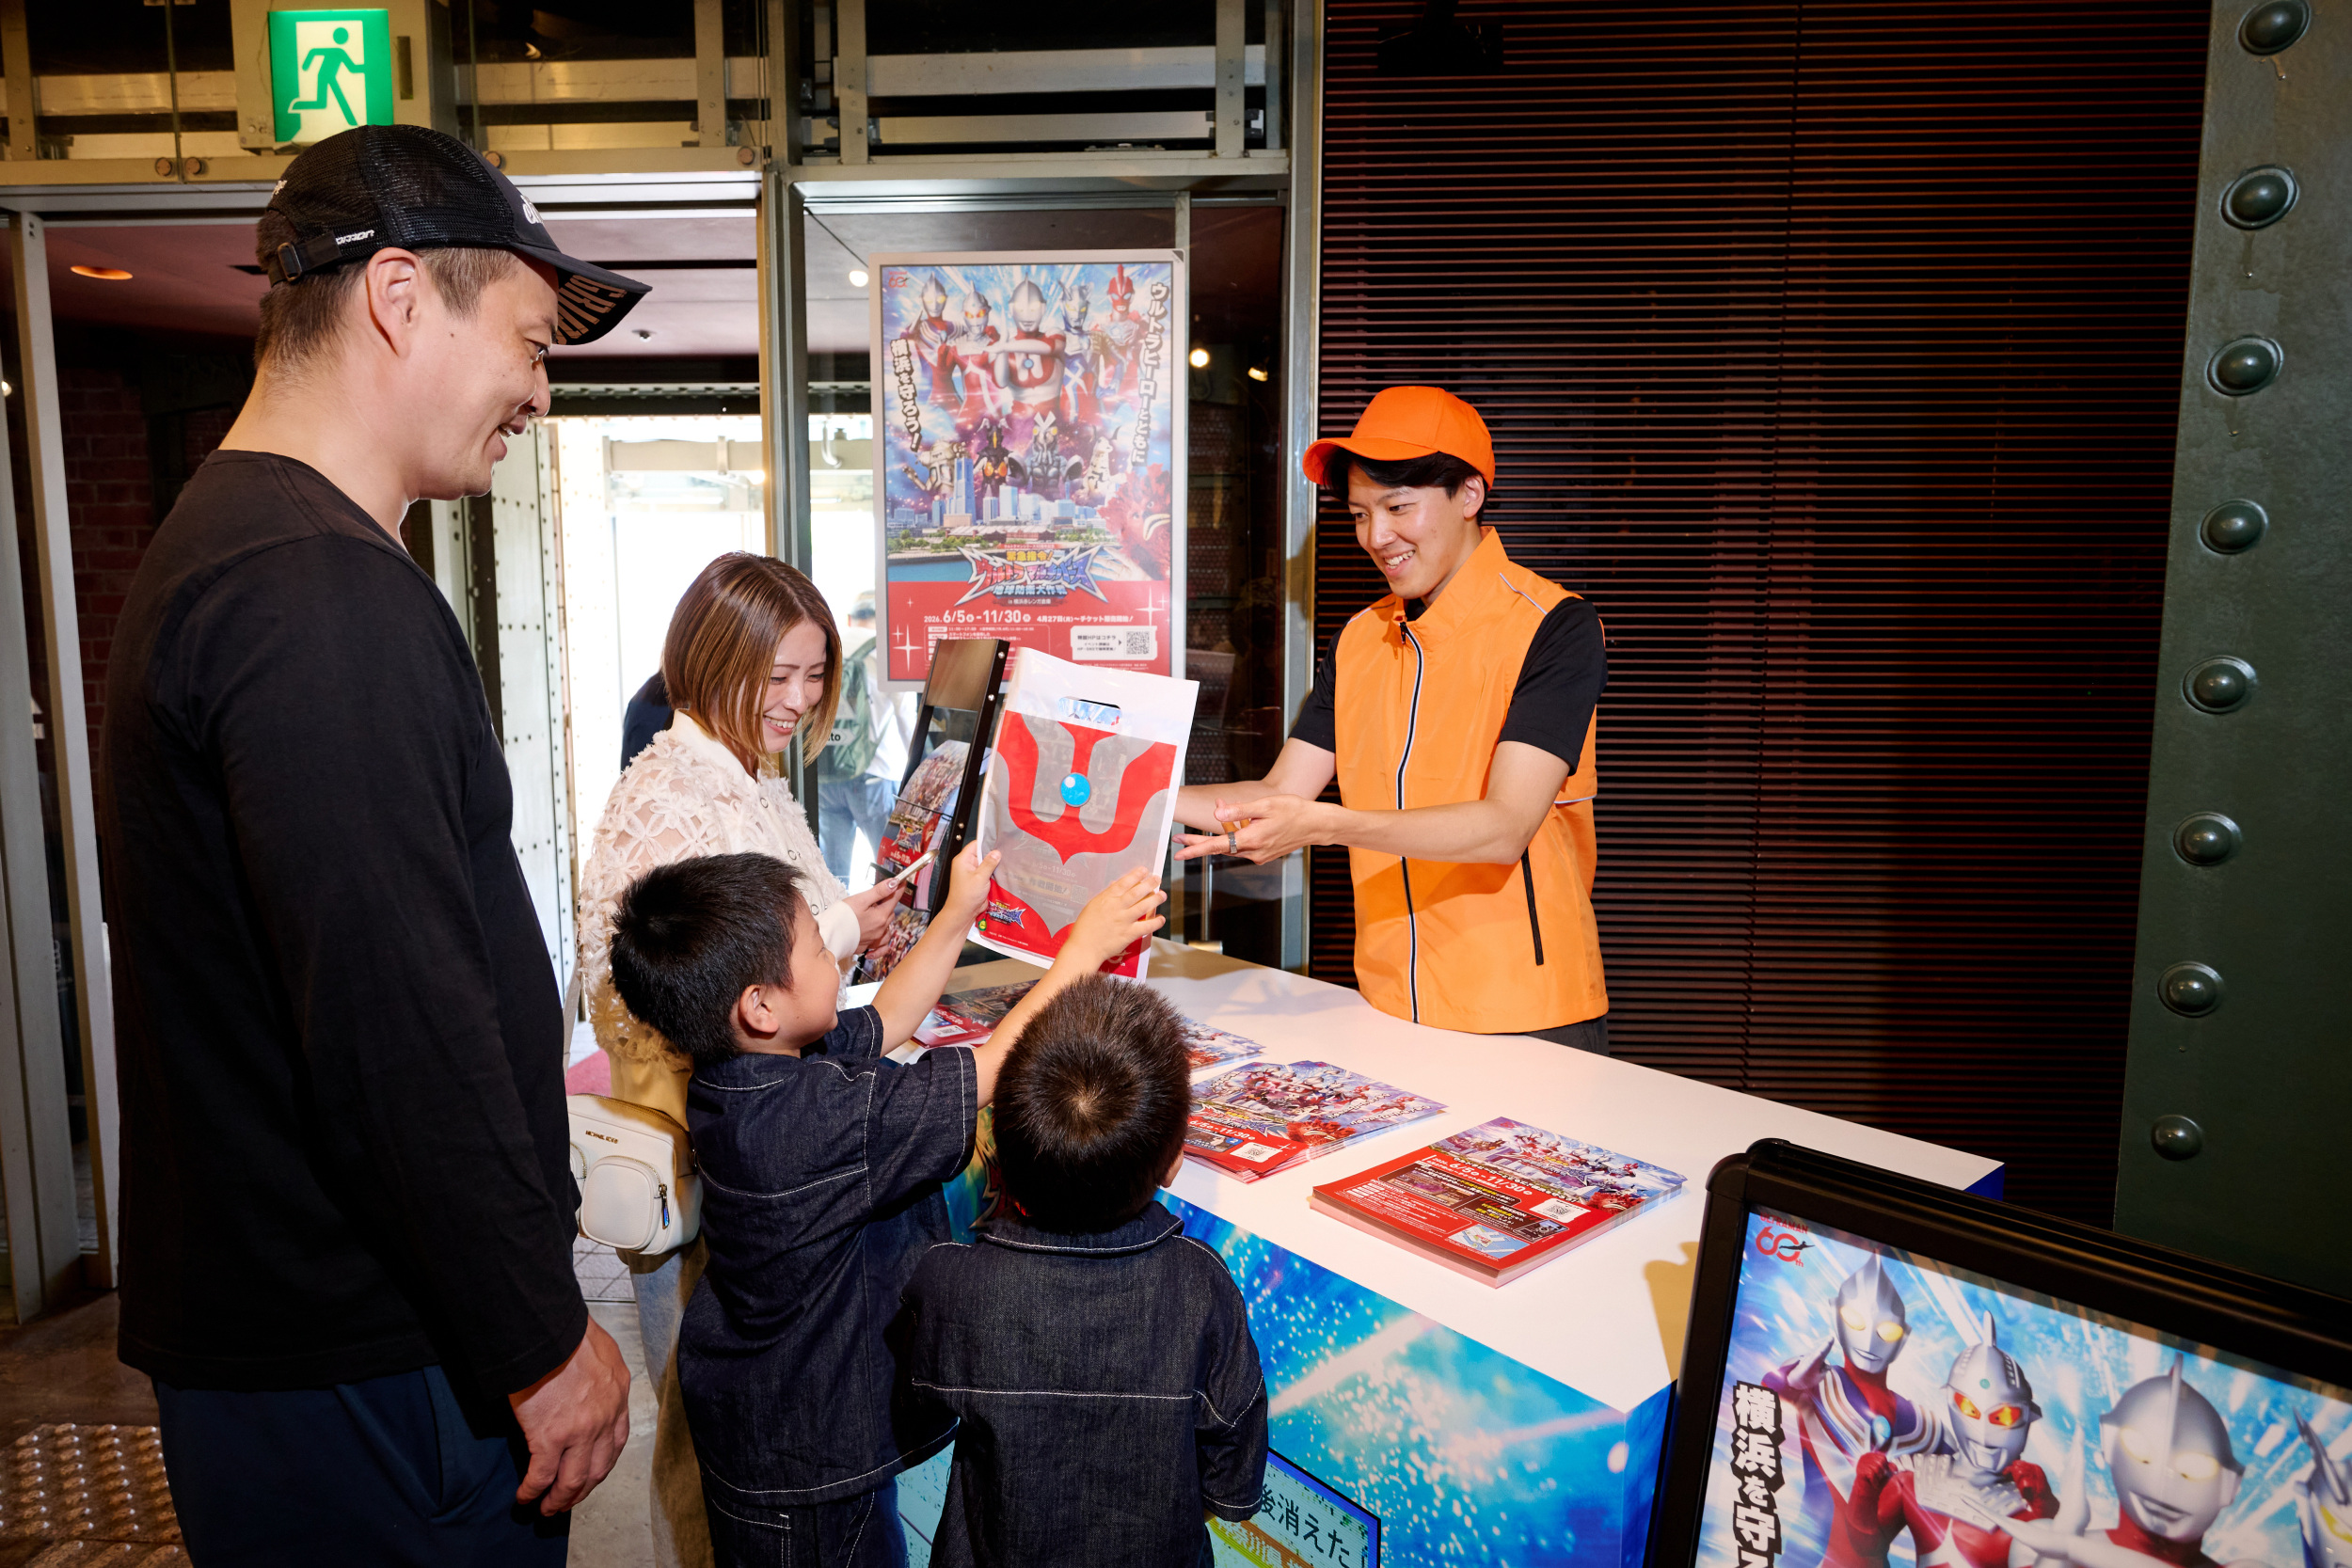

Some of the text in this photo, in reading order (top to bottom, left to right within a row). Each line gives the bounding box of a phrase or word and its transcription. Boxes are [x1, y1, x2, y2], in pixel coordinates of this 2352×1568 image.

[1131, 283, 1168, 464] ウルトラヒーローとともに
[1759, 1212, 1808, 1234] ULTRAMAN
